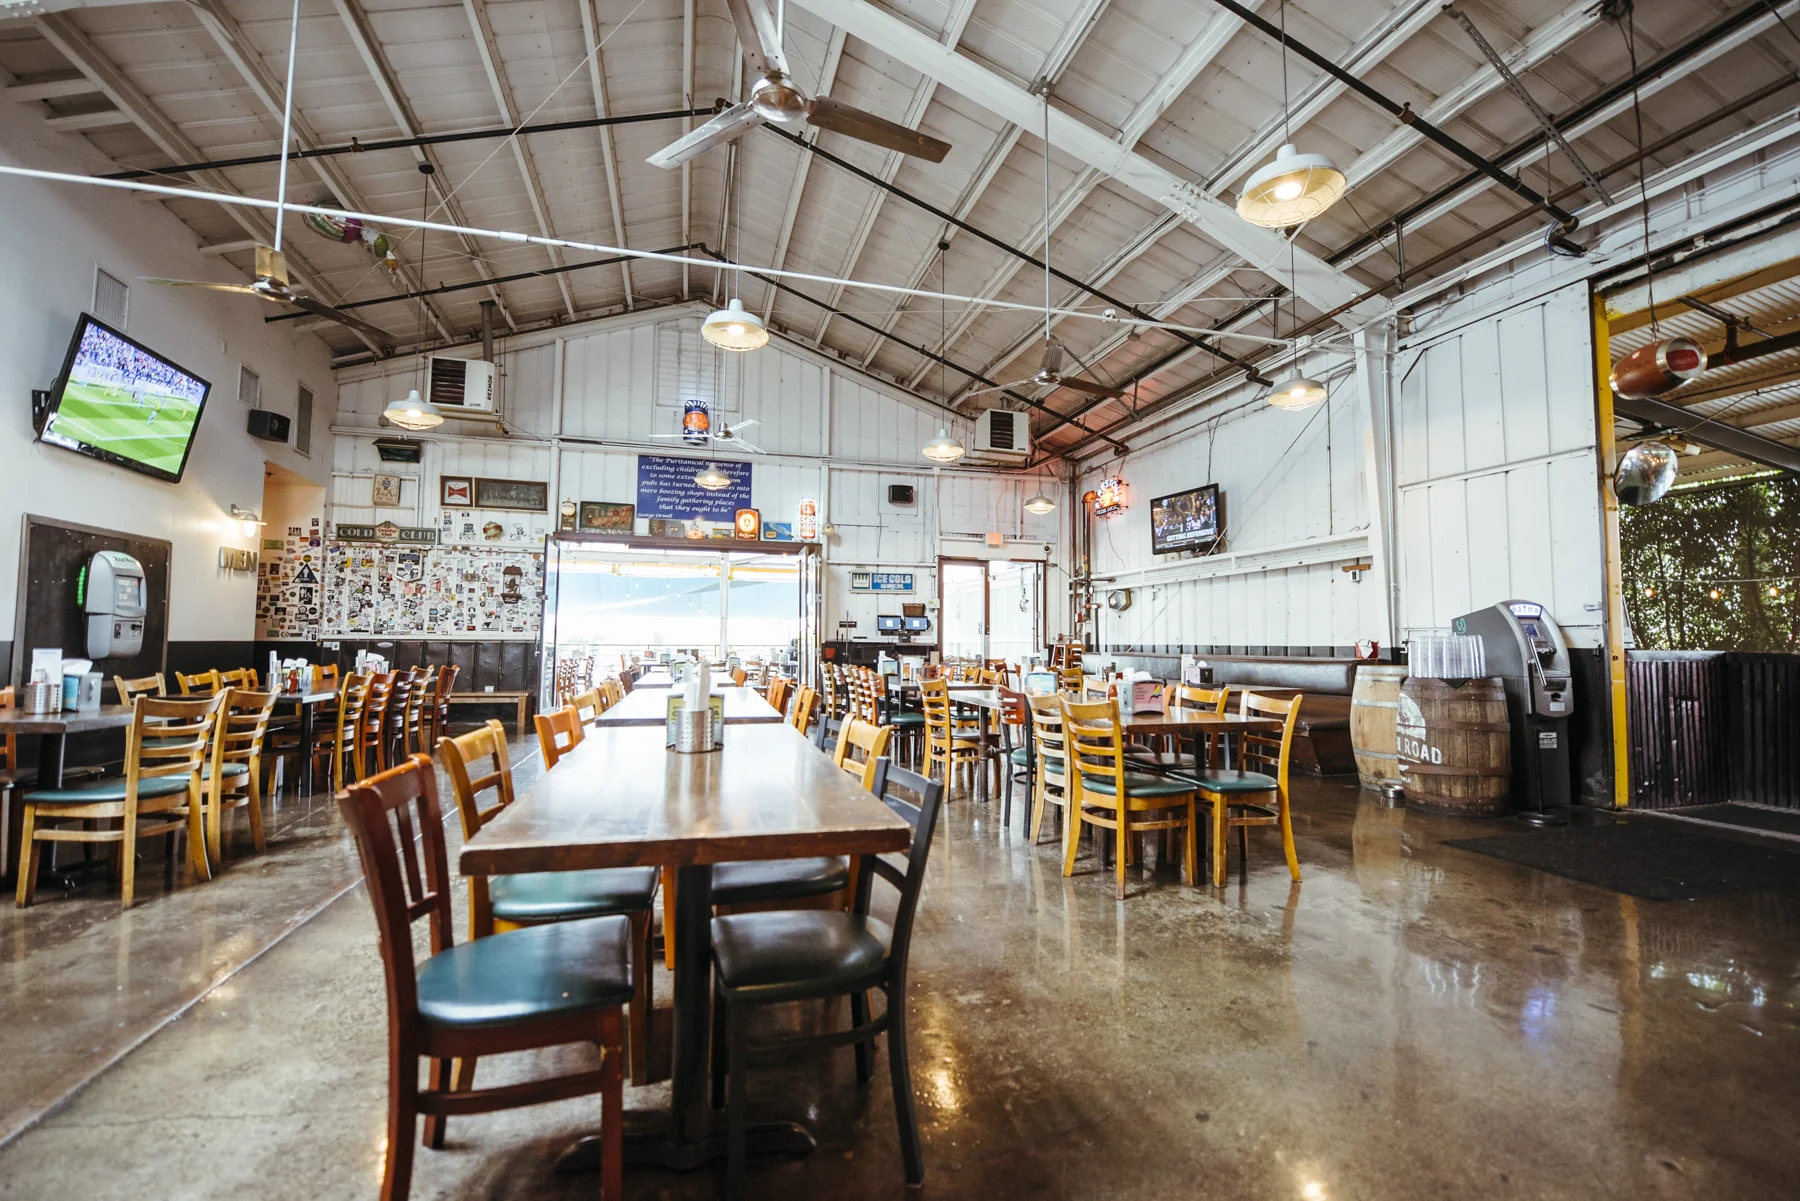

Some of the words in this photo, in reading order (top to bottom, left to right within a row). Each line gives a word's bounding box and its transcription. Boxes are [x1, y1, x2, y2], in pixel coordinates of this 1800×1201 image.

[666, 458, 704, 466] Puritanical
[642, 464, 675, 472] excluding
[720, 469, 750, 477] therefore
[659, 488, 685, 496] boozing
[706, 490, 730, 498] instead
[680, 497, 714, 506] gathering
[339, 528, 374, 537] COLD
[402, 530, 435, 540] CLUB
[1187, 528, 1214, 538] DEFENSIVE
[220, 546, 258, 572] MEN
[874, 574, 887, 583] ICE
[889, 575, 911, 584] COLD
[1404, 738, 1442, 765] ROAD
